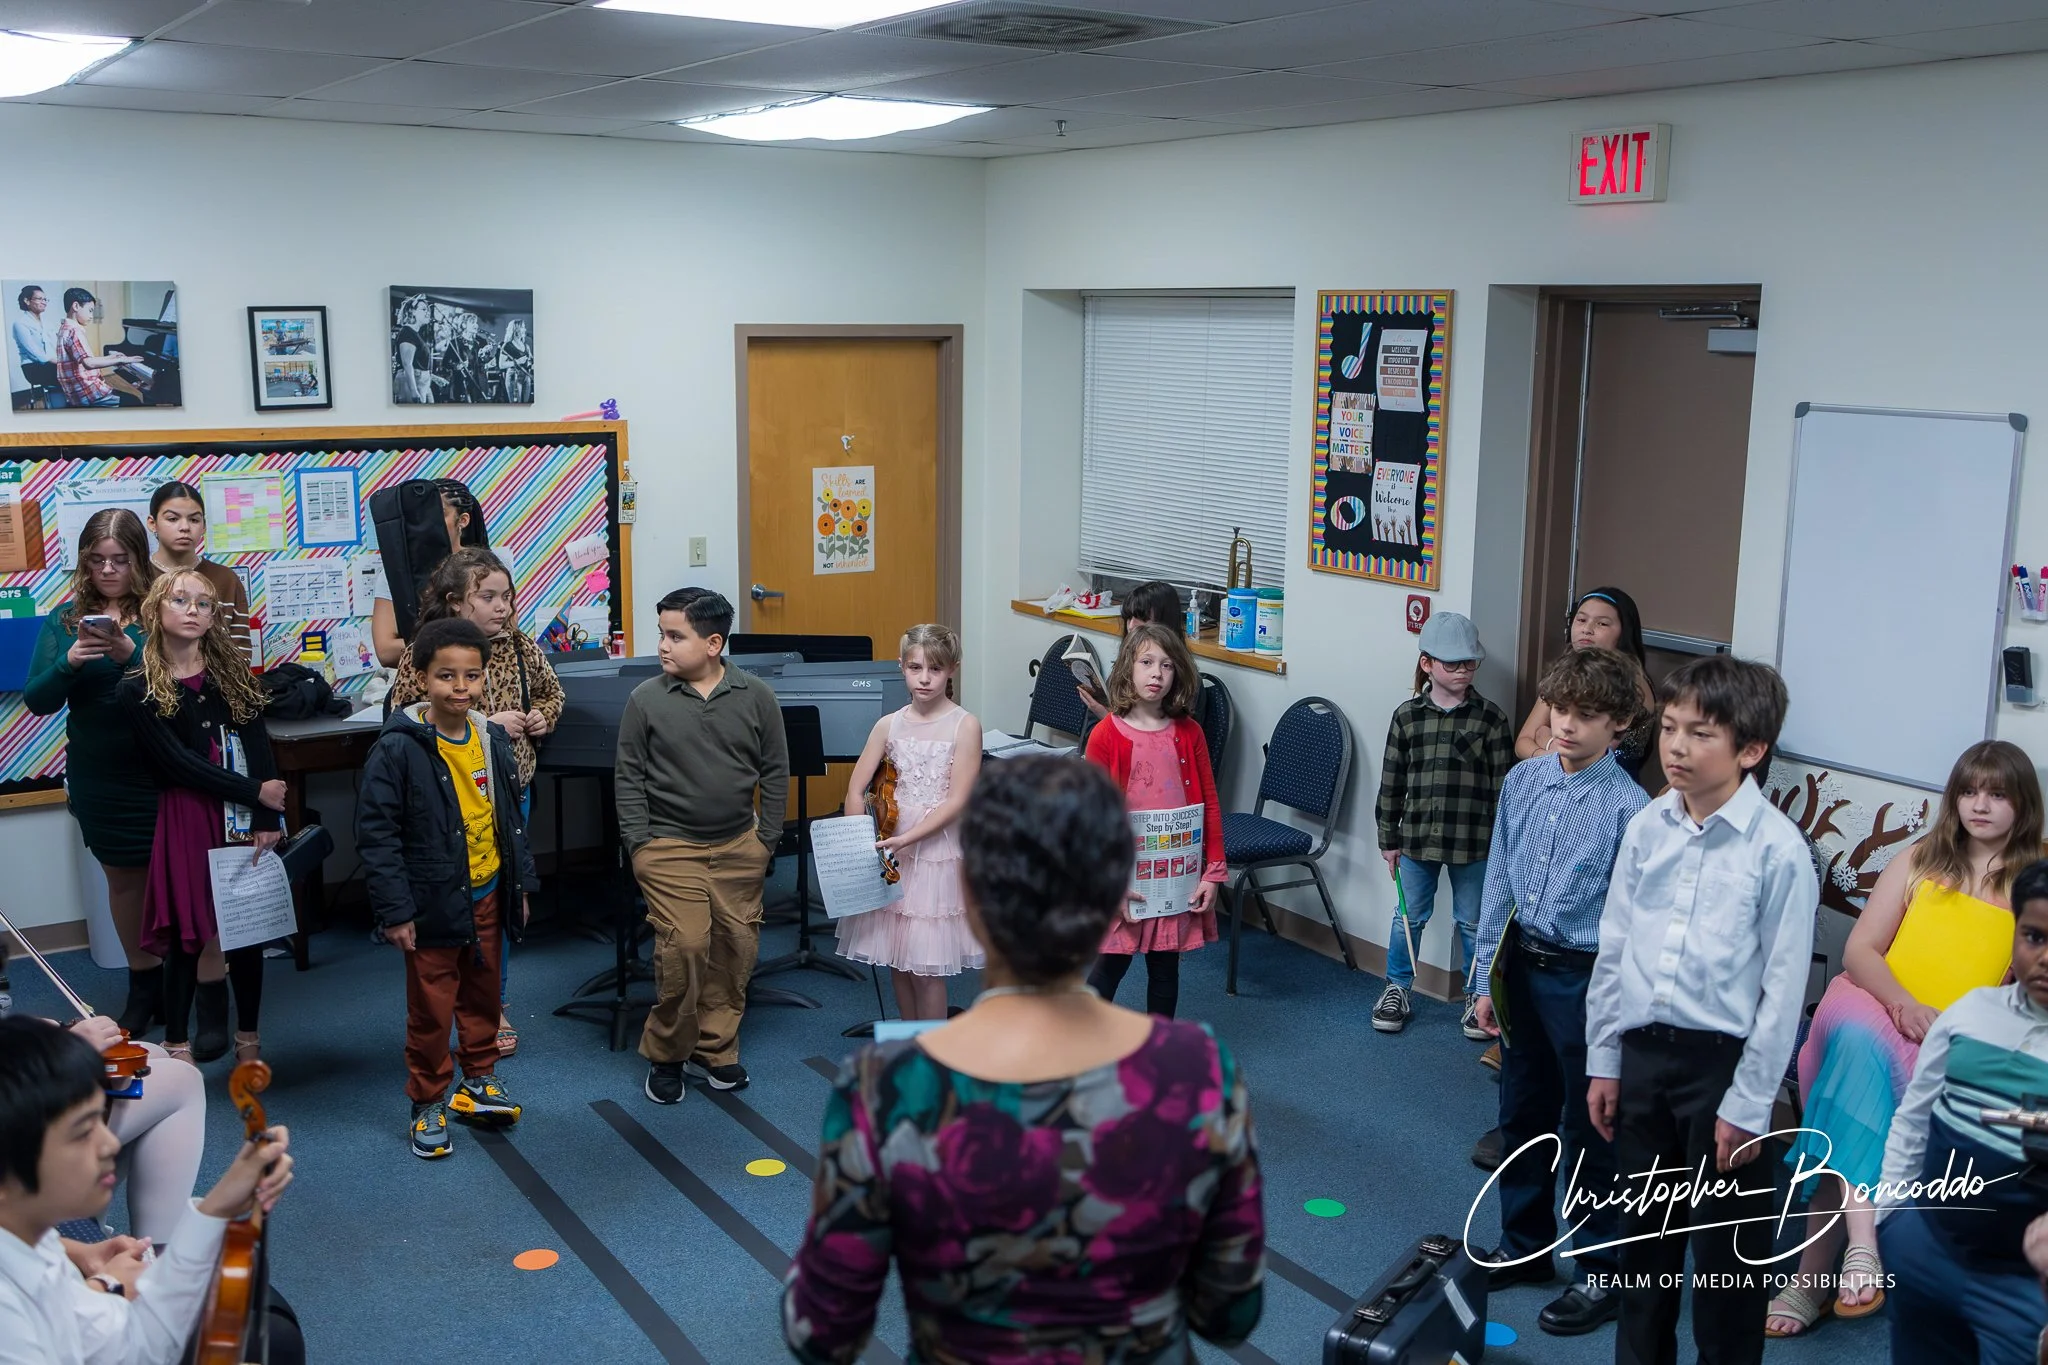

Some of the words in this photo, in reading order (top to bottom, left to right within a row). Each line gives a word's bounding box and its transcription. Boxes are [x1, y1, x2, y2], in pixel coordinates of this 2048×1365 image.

[1580, 132, 1650, 195] EXIT
[1341, 410, 1364, 422] YOUR
[1339, 427, 1364, 439] VOICE
[1332, 443, 1369, 456] MATTERS
[1376, 467, 1415, 484] EVERYONE
[1375, 490, 1411, 506] Welcome
[1132, 814, 1151, 824] STEP
[1153, 813, 1170, 822] INTO
[1146, 823, 1163, 833] Step
[1165, 822, 1174, 833] by
[1175, 819, 1192, 831] Step!
